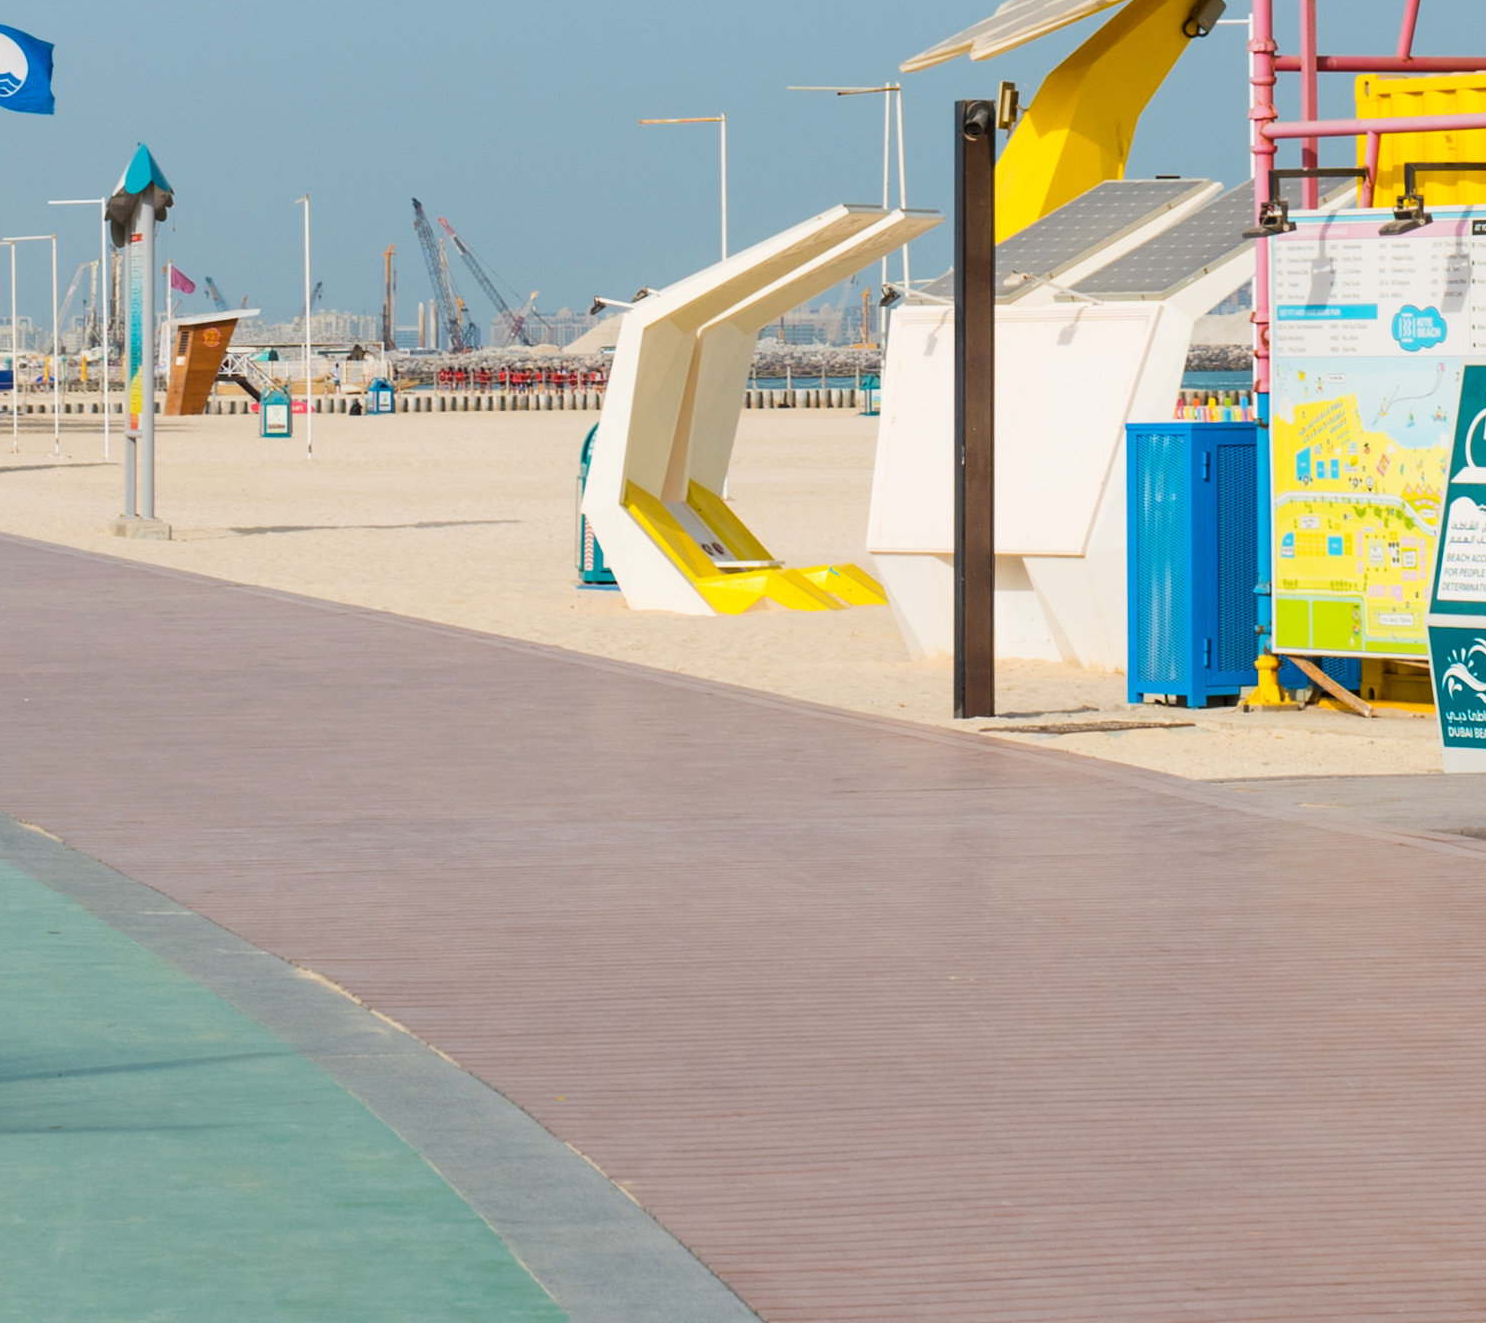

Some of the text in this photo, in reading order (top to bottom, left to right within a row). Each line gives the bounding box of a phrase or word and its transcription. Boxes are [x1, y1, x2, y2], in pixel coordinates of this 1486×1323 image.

[1417, 317, 1433, 327] KITE
[1417, 328, 1442, 338] BEACH
[1446, 553, 1470, 563] BEACH
[1444, 567, 1458, 577] FOR
[1459, 568, 1486, 578] PEOPLE
[1445, 711, 1467, 724] دبي
[1448, 726, 1473, 738] DUBAI
